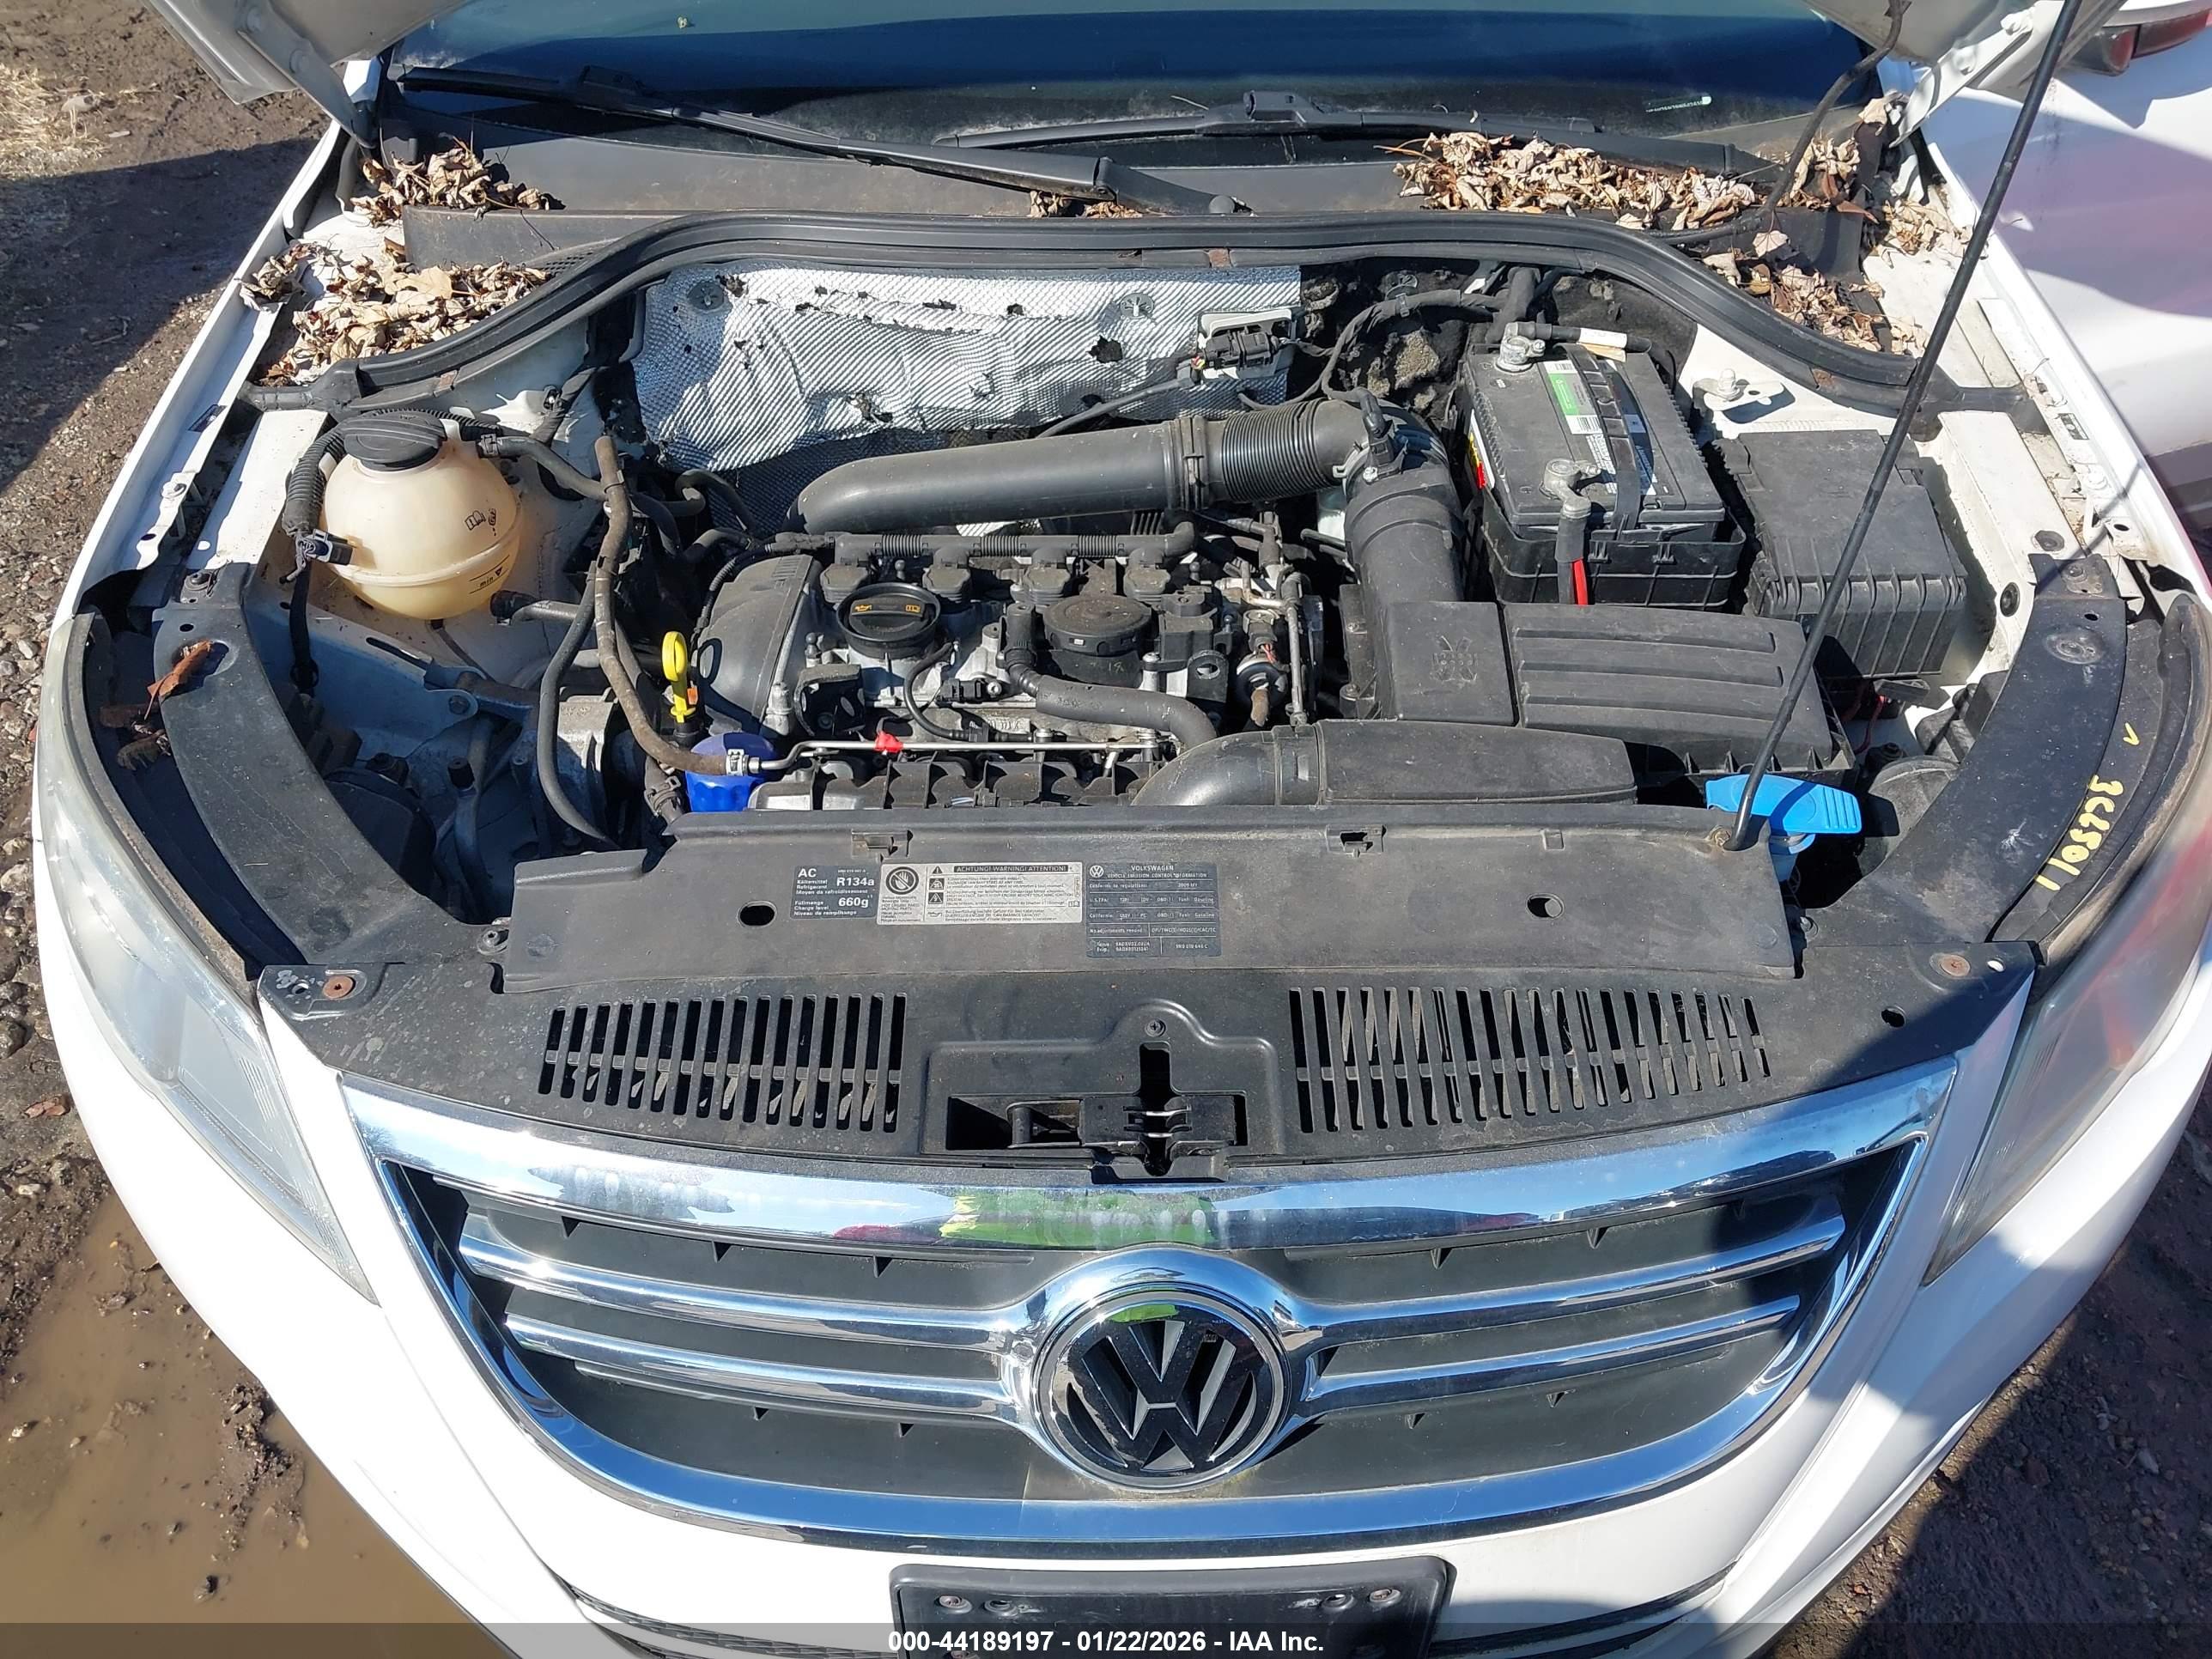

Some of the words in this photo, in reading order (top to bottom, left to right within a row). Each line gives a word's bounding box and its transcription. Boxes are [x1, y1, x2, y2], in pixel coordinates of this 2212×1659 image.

[478, 576, 494, 587] min
[798, 868, 817, 878] AC
[836, 877, 875, 886] R134a
[838, 897, 869, 908] 660g
